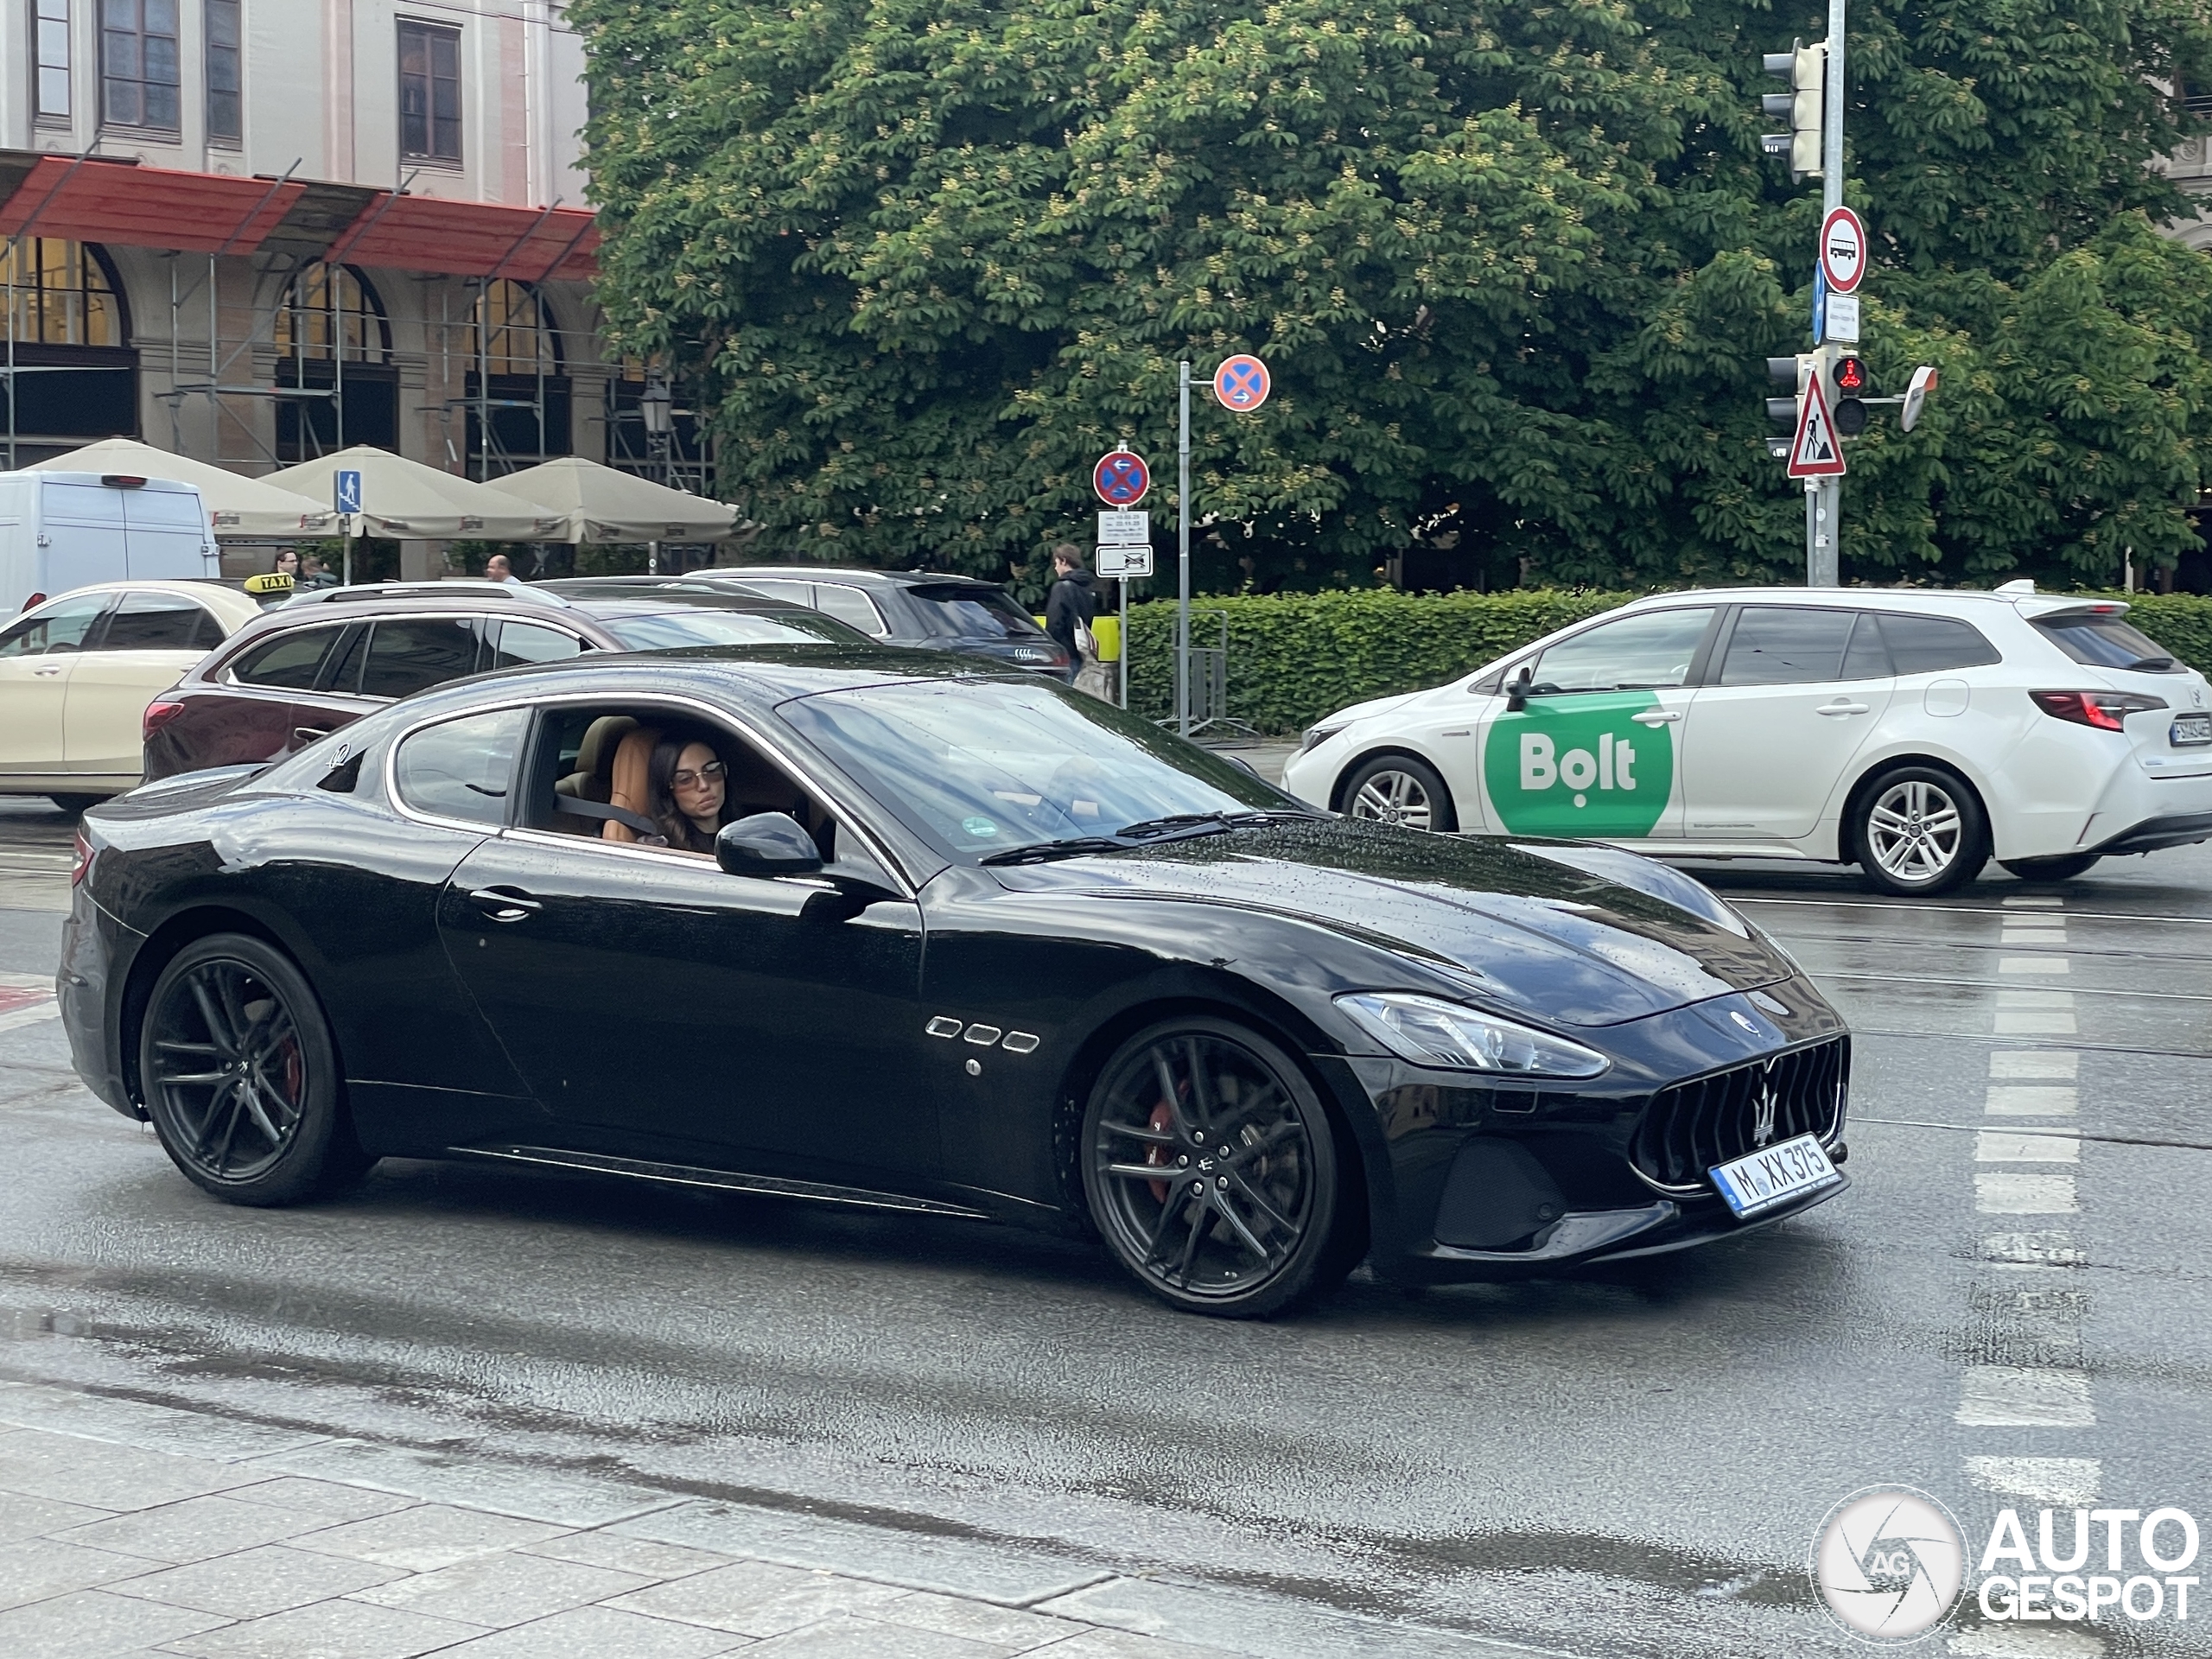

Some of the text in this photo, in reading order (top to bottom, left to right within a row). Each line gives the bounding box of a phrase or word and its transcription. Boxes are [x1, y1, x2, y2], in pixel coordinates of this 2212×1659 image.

[262, 575, 290, 588] TAXI
[1521, 733, 1637, 808] Bolt
[1732, 1165, 1760, 1200] M
[1757, 1152, 1796, 1190] XX
[1783, 1141, 1825, 1179] 375
